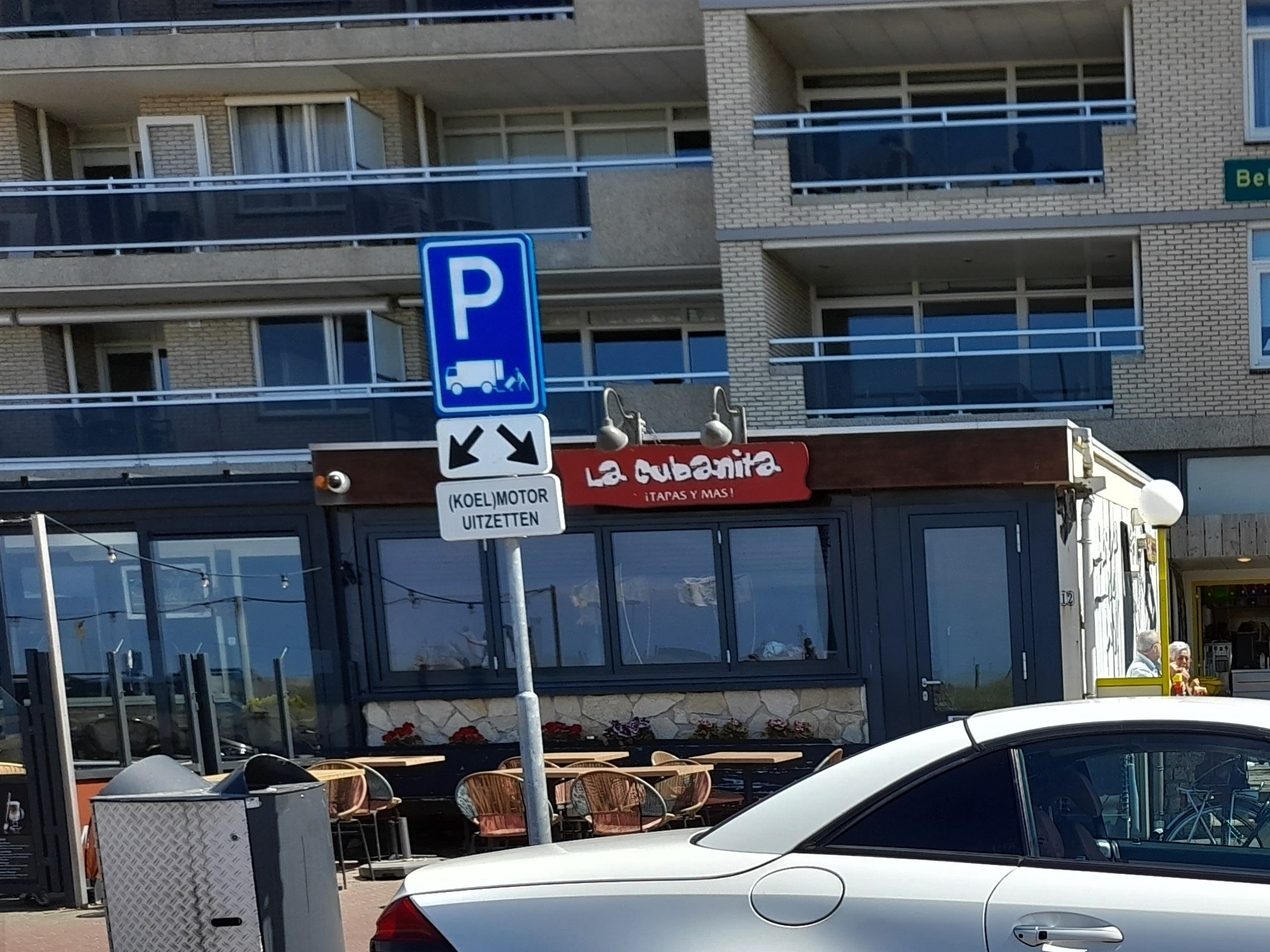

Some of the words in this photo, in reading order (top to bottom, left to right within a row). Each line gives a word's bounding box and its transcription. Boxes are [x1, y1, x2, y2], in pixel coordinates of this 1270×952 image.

[448, 255, 504, 341] P
[449, 488, 549, 513] (KOEL)MOTOR
[689, 489, 698, 500] Y
[462, 511, 540, 530] UITZETTEN
[1061, 590, 1075, 606] 12
